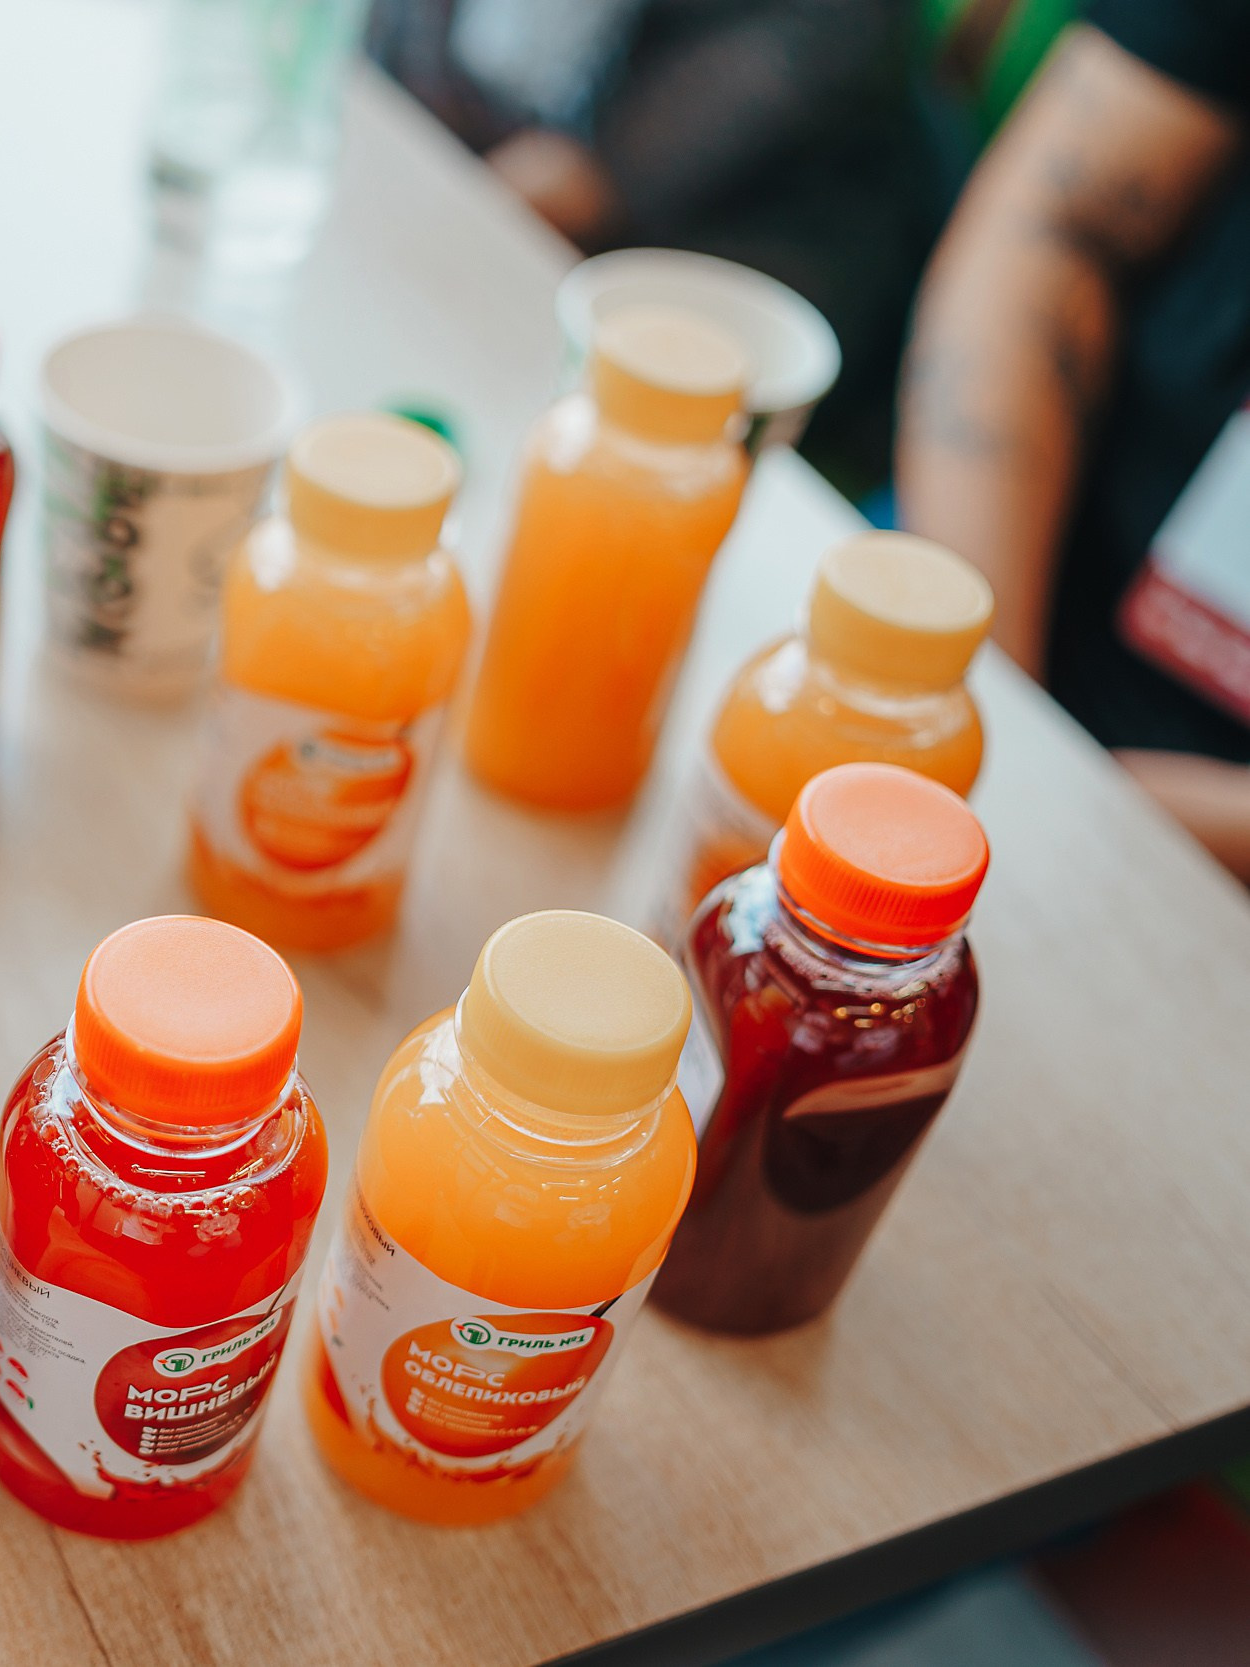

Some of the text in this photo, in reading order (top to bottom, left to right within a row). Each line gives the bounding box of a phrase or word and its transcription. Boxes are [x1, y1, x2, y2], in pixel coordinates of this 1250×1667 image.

[201, 1318, 276, 1363] ГРИЛЬ №1
[498, 1334, 586, 1349] ГРИЛЬ №1
[123, 1351, 278, 1421] ВИШНЕВЫЙ
[403, 1359, 588, 1406] ОБЛЕПИХОВЫЙ
[407, 1341, 507, 1388] МОРС
[127, 1374, 230, 1404] МОРС
